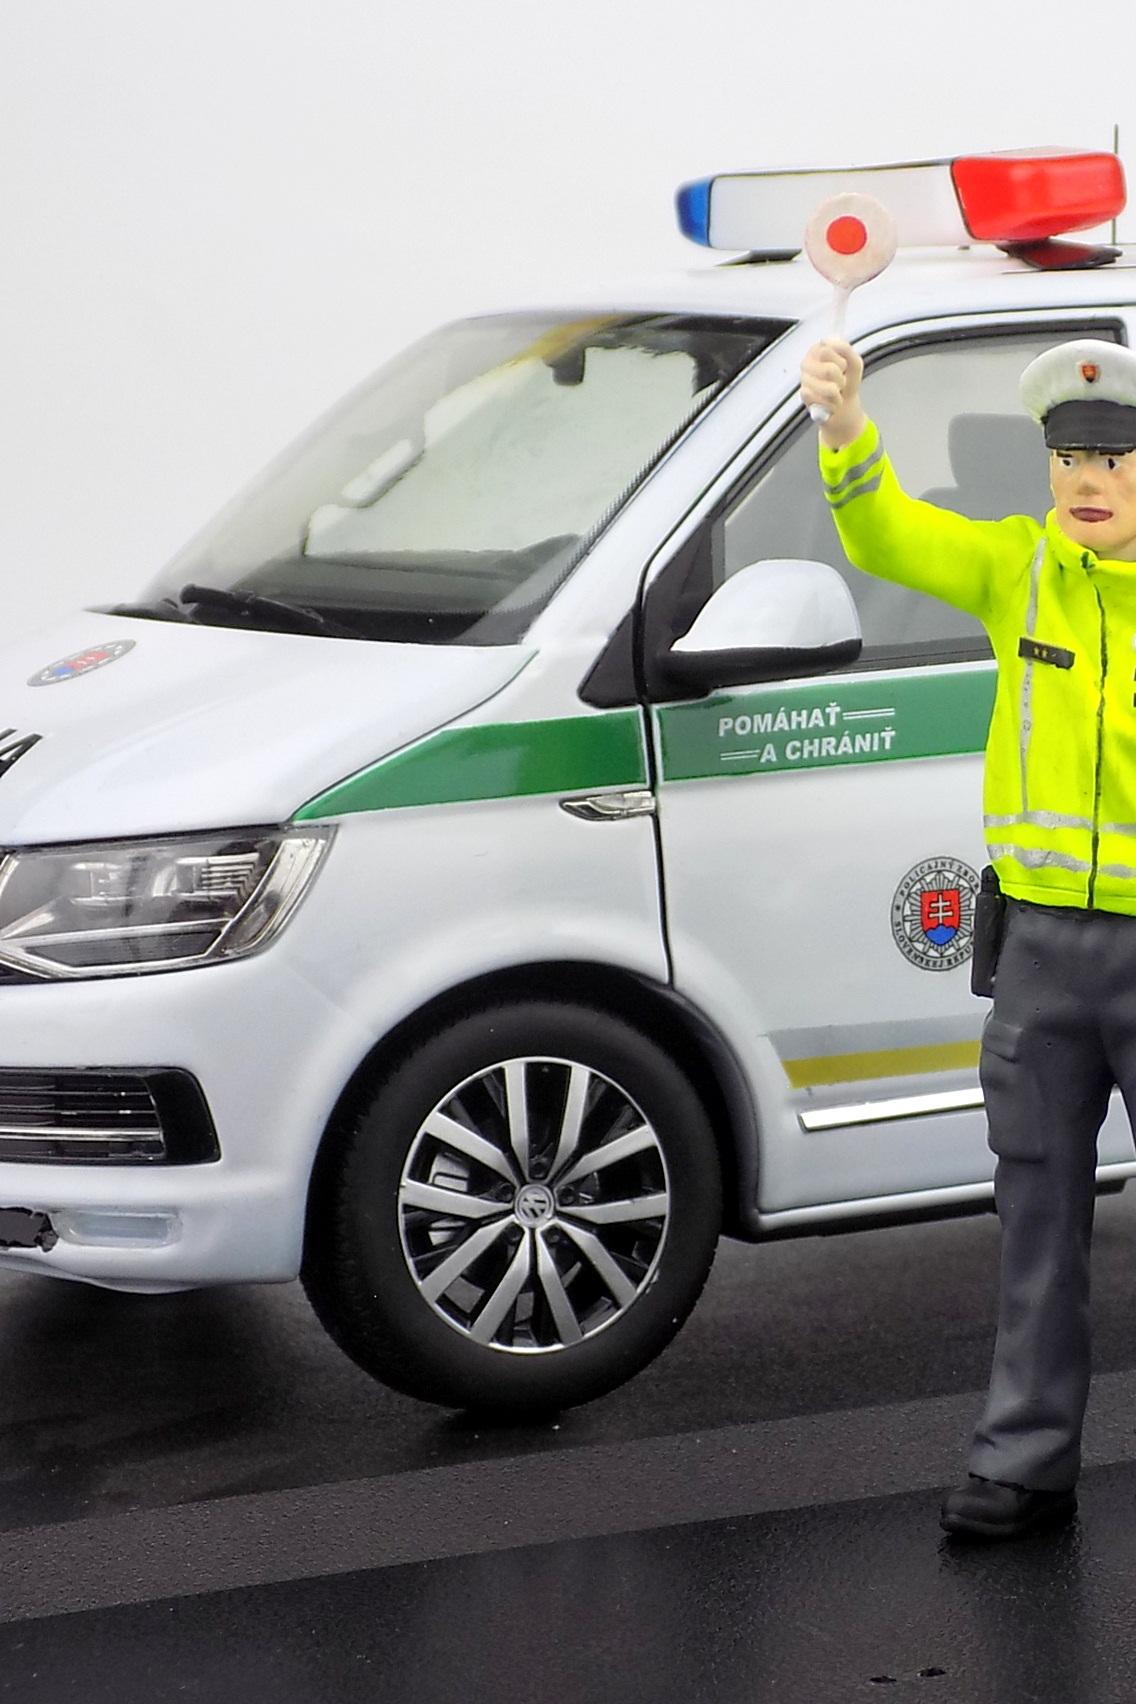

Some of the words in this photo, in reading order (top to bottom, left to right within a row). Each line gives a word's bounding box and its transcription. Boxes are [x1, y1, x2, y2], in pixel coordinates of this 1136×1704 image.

[718, 702, 842, 737] POMÁHAŤ
[759, 743, 778, 763] A
[785, 726, 896, 761] CHRÁNIŤ
